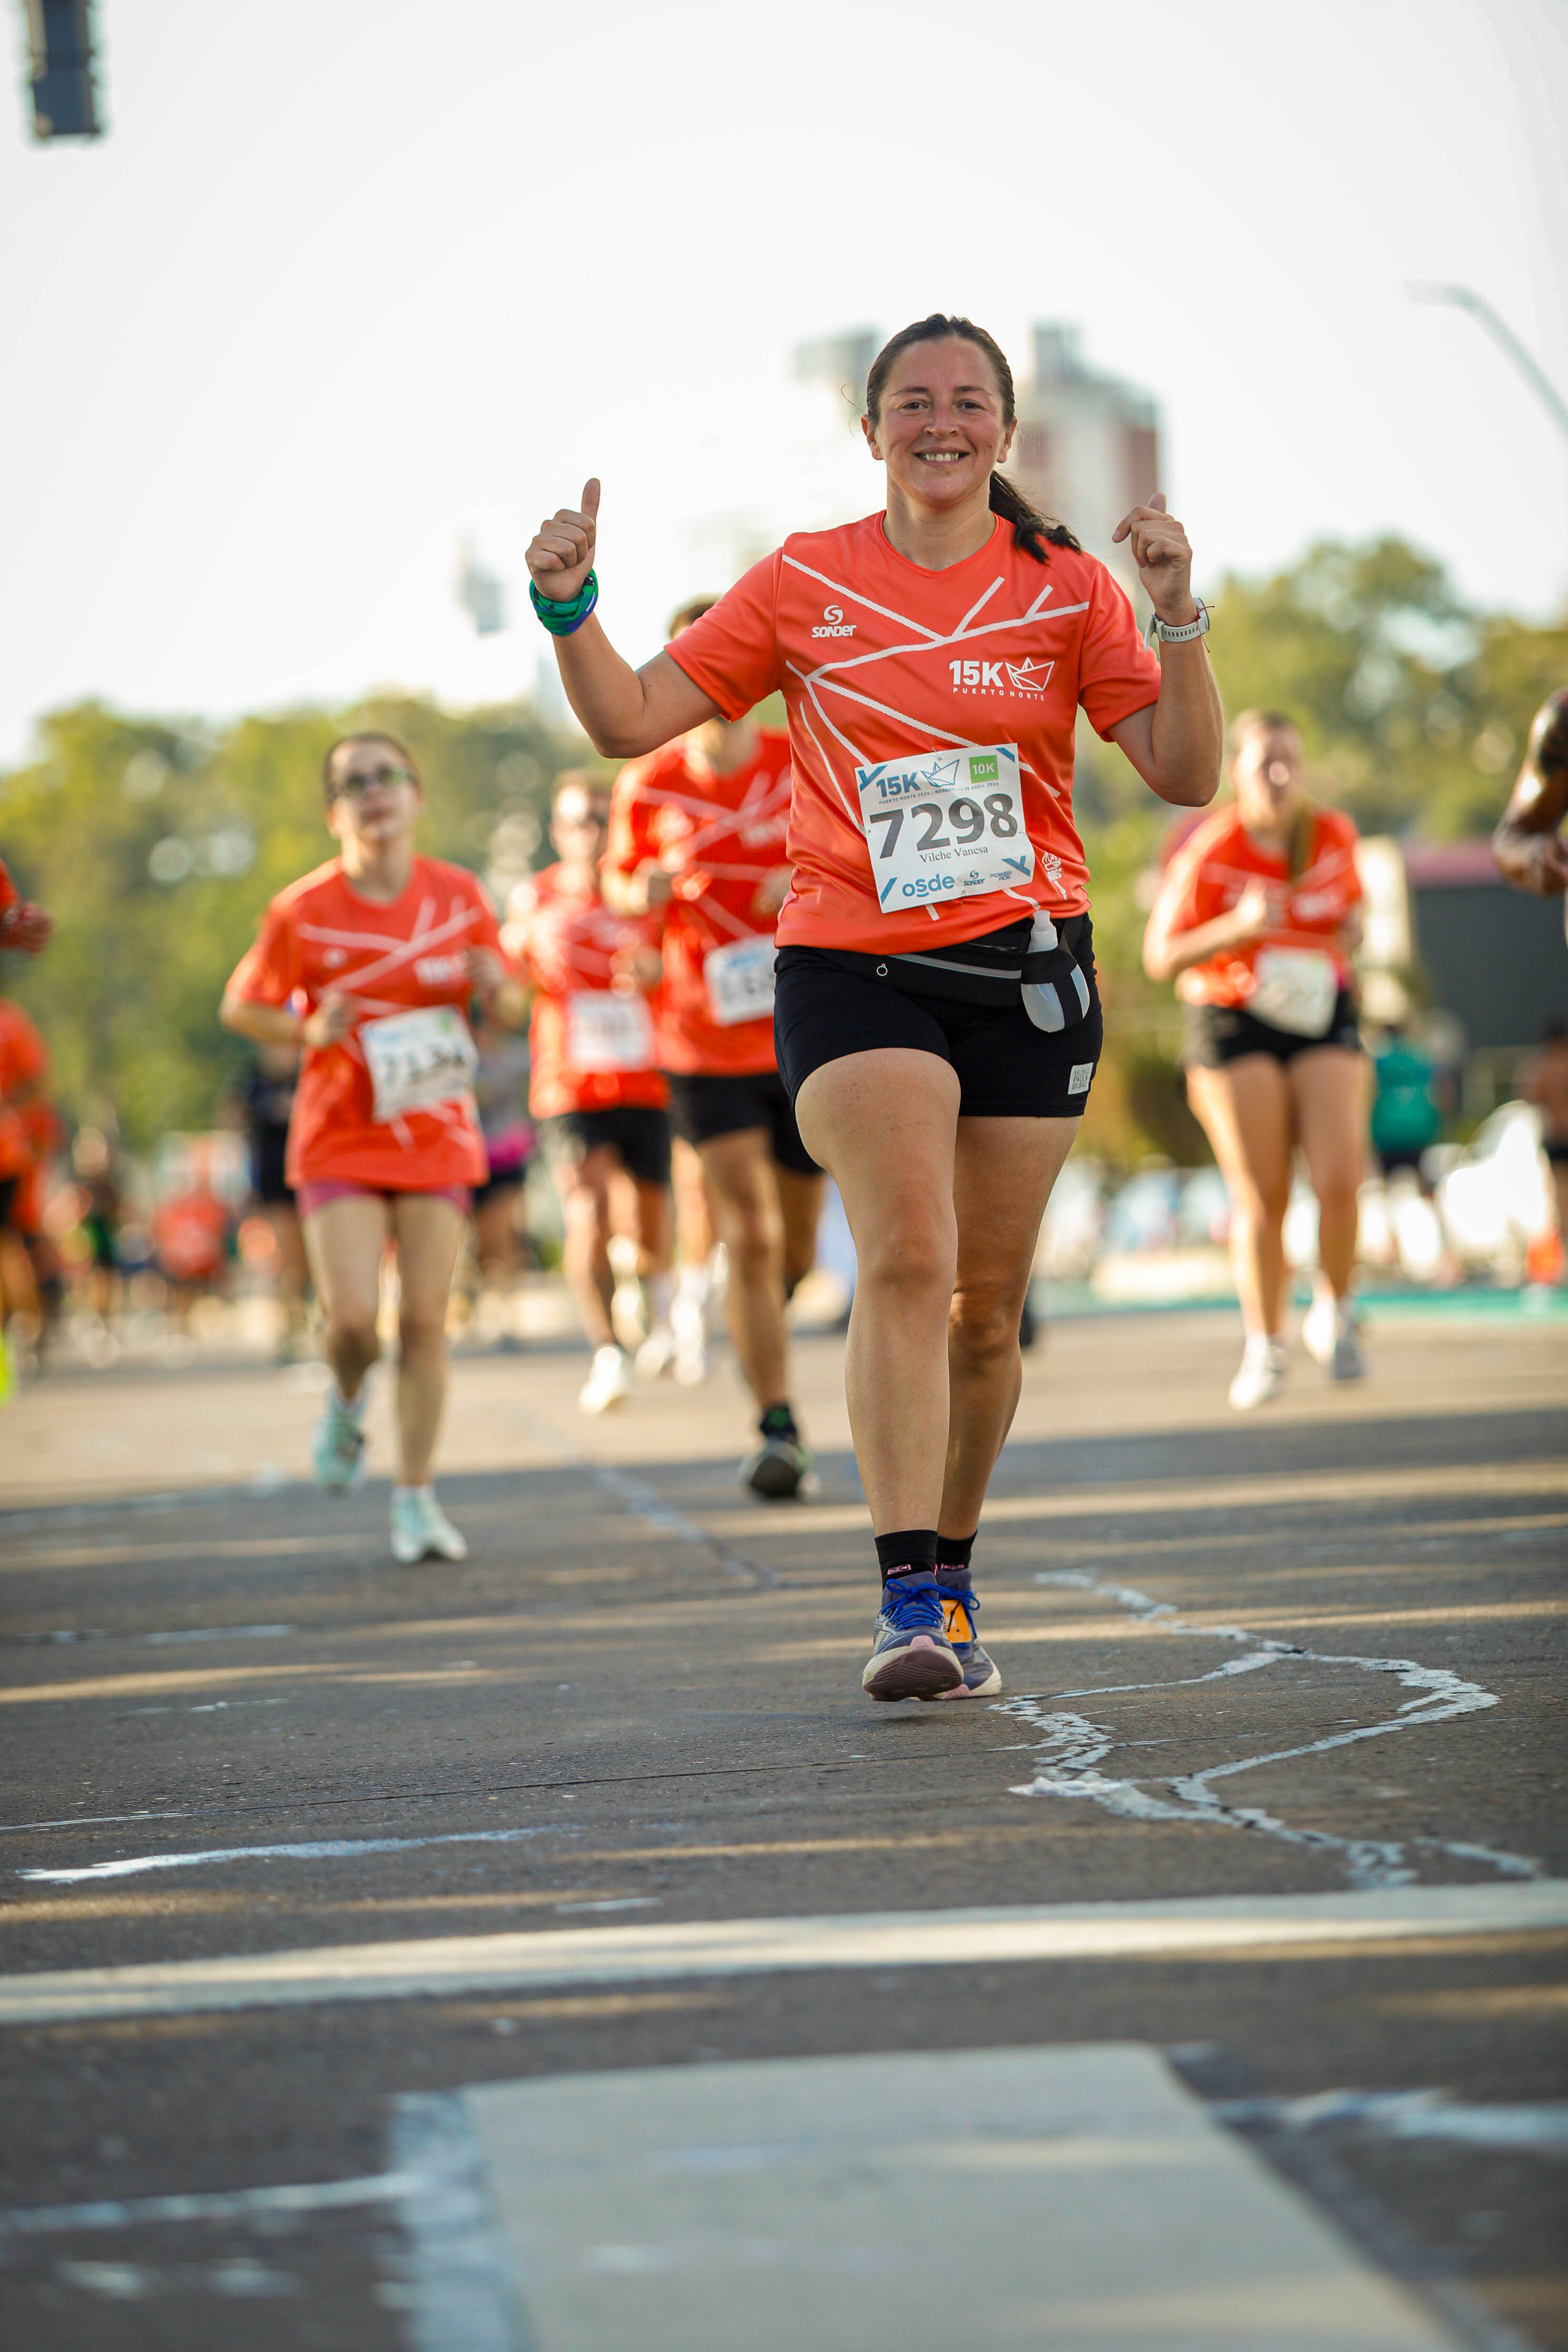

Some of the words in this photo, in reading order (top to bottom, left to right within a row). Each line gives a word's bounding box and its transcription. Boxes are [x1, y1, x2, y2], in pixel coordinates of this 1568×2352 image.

[949, 660, 1004, 687] 15K
[953, 687, 1004, 696] PUERTO
[1010, 691, 1044, 701] NORTE
[973, 763, 995, 776] 10K
[876, 771, 921, 798] 15K
[869, 793, 1018, 859] 7298
[919, 849, 952, 863] Vilche
[954, 845, 988, 857] Vanesa
[902, 873, 955, 897] osde
